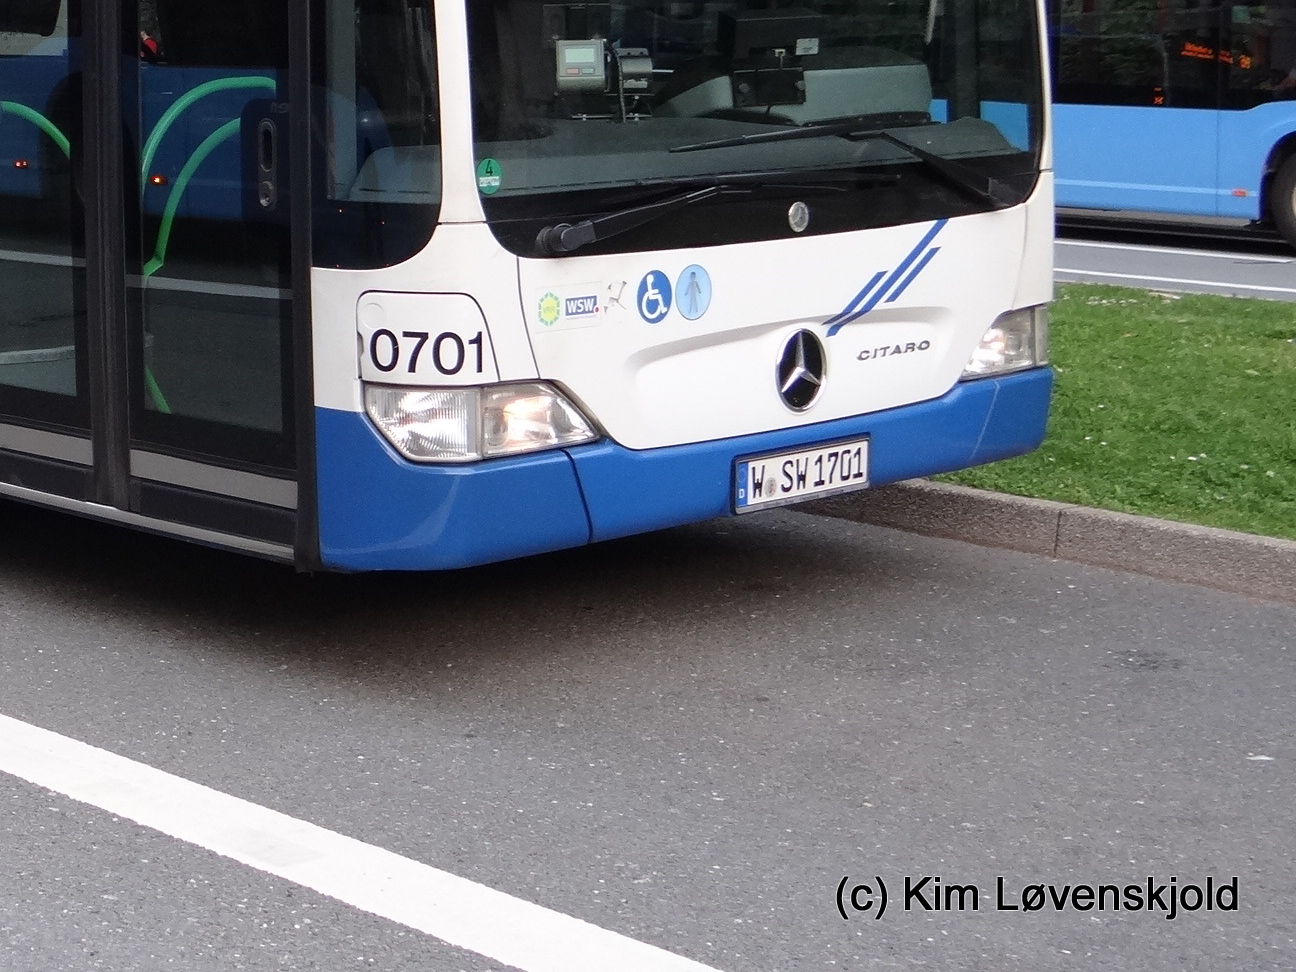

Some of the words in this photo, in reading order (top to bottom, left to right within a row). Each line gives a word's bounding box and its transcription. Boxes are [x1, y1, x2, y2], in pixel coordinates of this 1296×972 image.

[485, 159, 494, 176] 4
[370, 328, 483, 376] 0701
[856, 340, 930, 361] CITARO
[751, 465, 765, 499] W
[781, 457, 808, 493] SW
[813, 447, 864, 487] 1701
[738, 488, 745, 499] D
